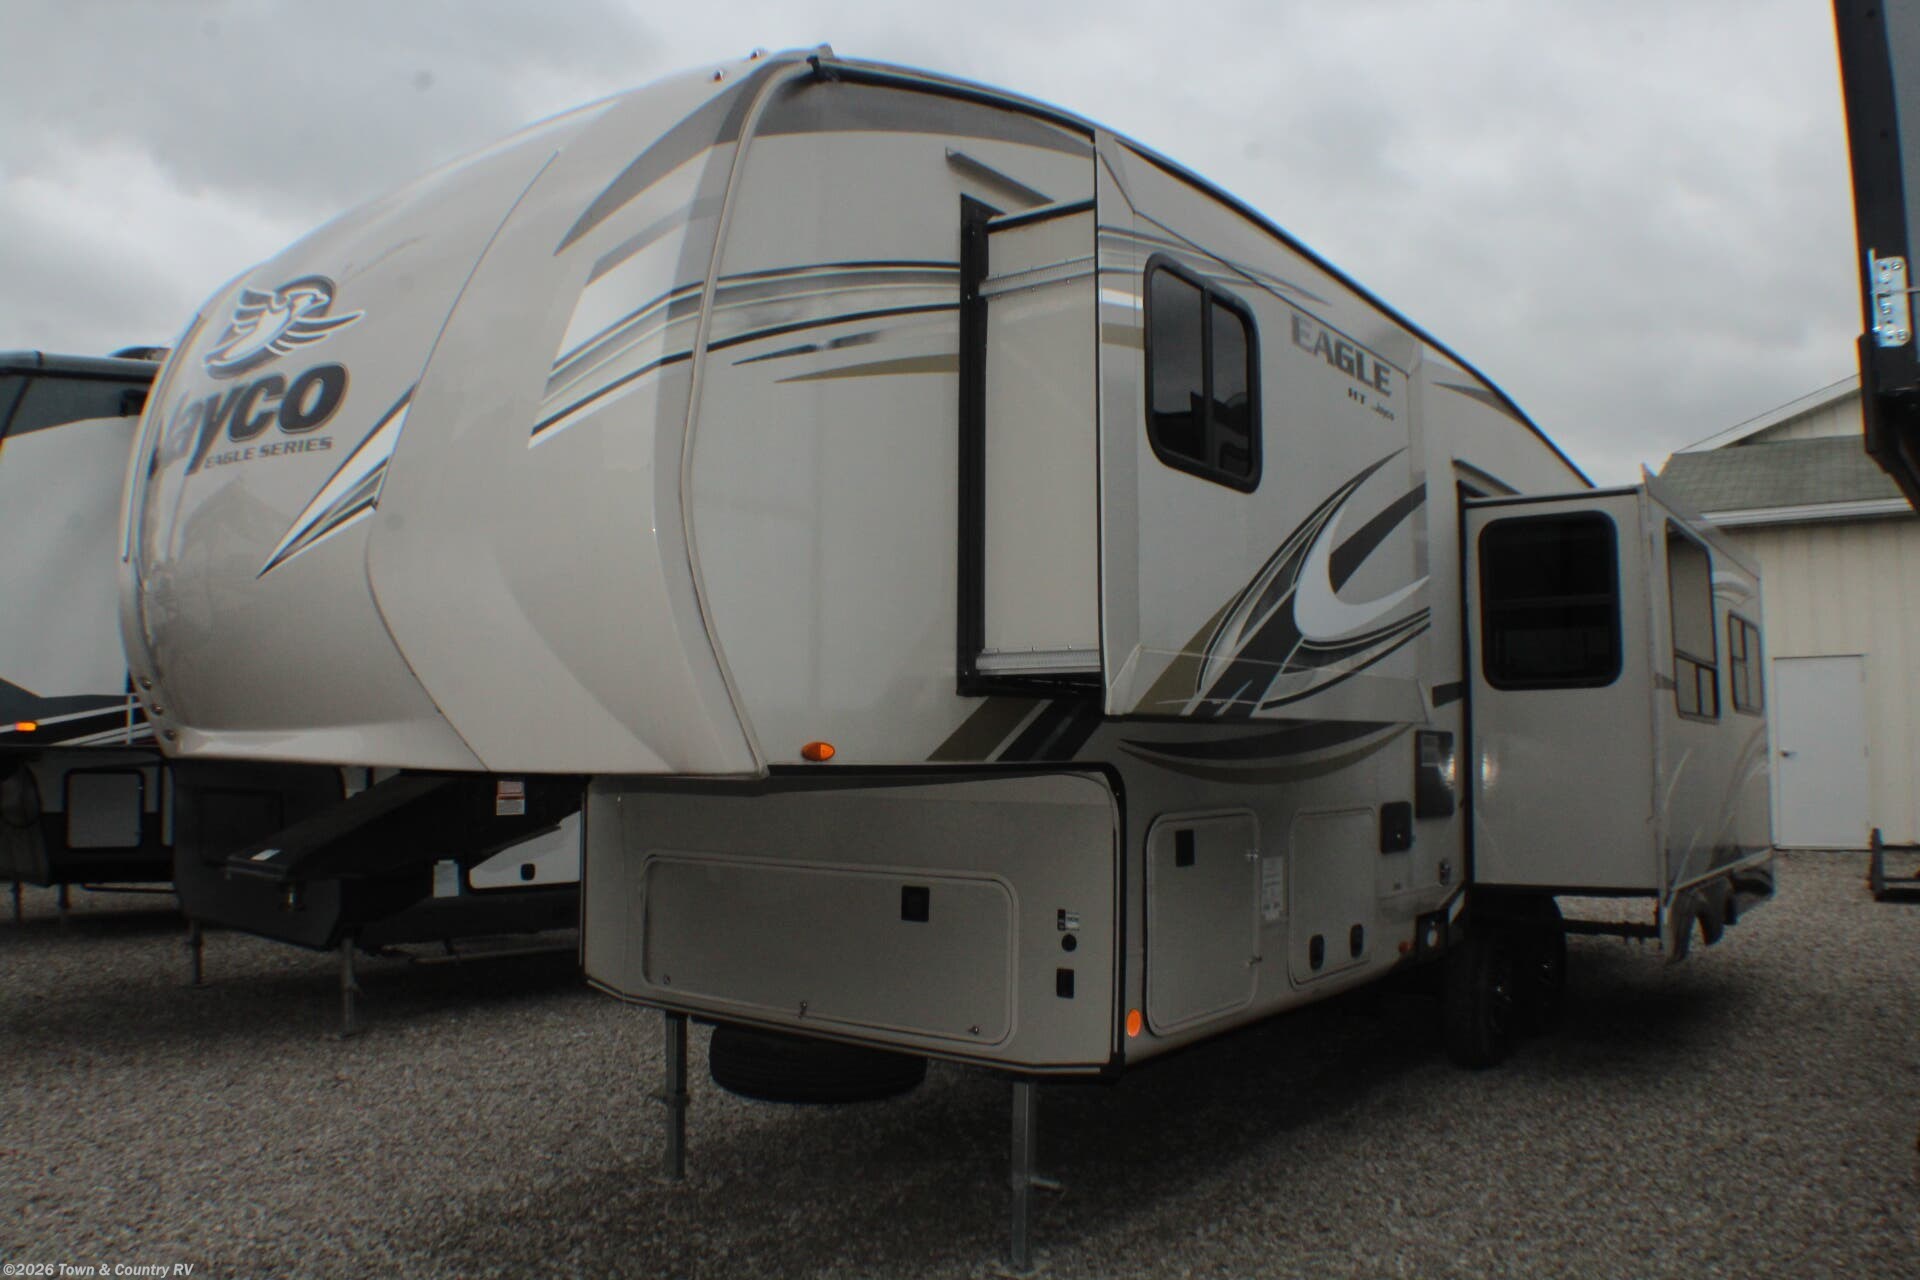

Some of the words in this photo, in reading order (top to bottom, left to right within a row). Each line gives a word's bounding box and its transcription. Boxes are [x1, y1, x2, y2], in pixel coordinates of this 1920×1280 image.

[1291, 313, 1392, 398] EAGLE
[204, 447, 256, 469] EAGLE
[259, 436, 334, 458] SERIES
